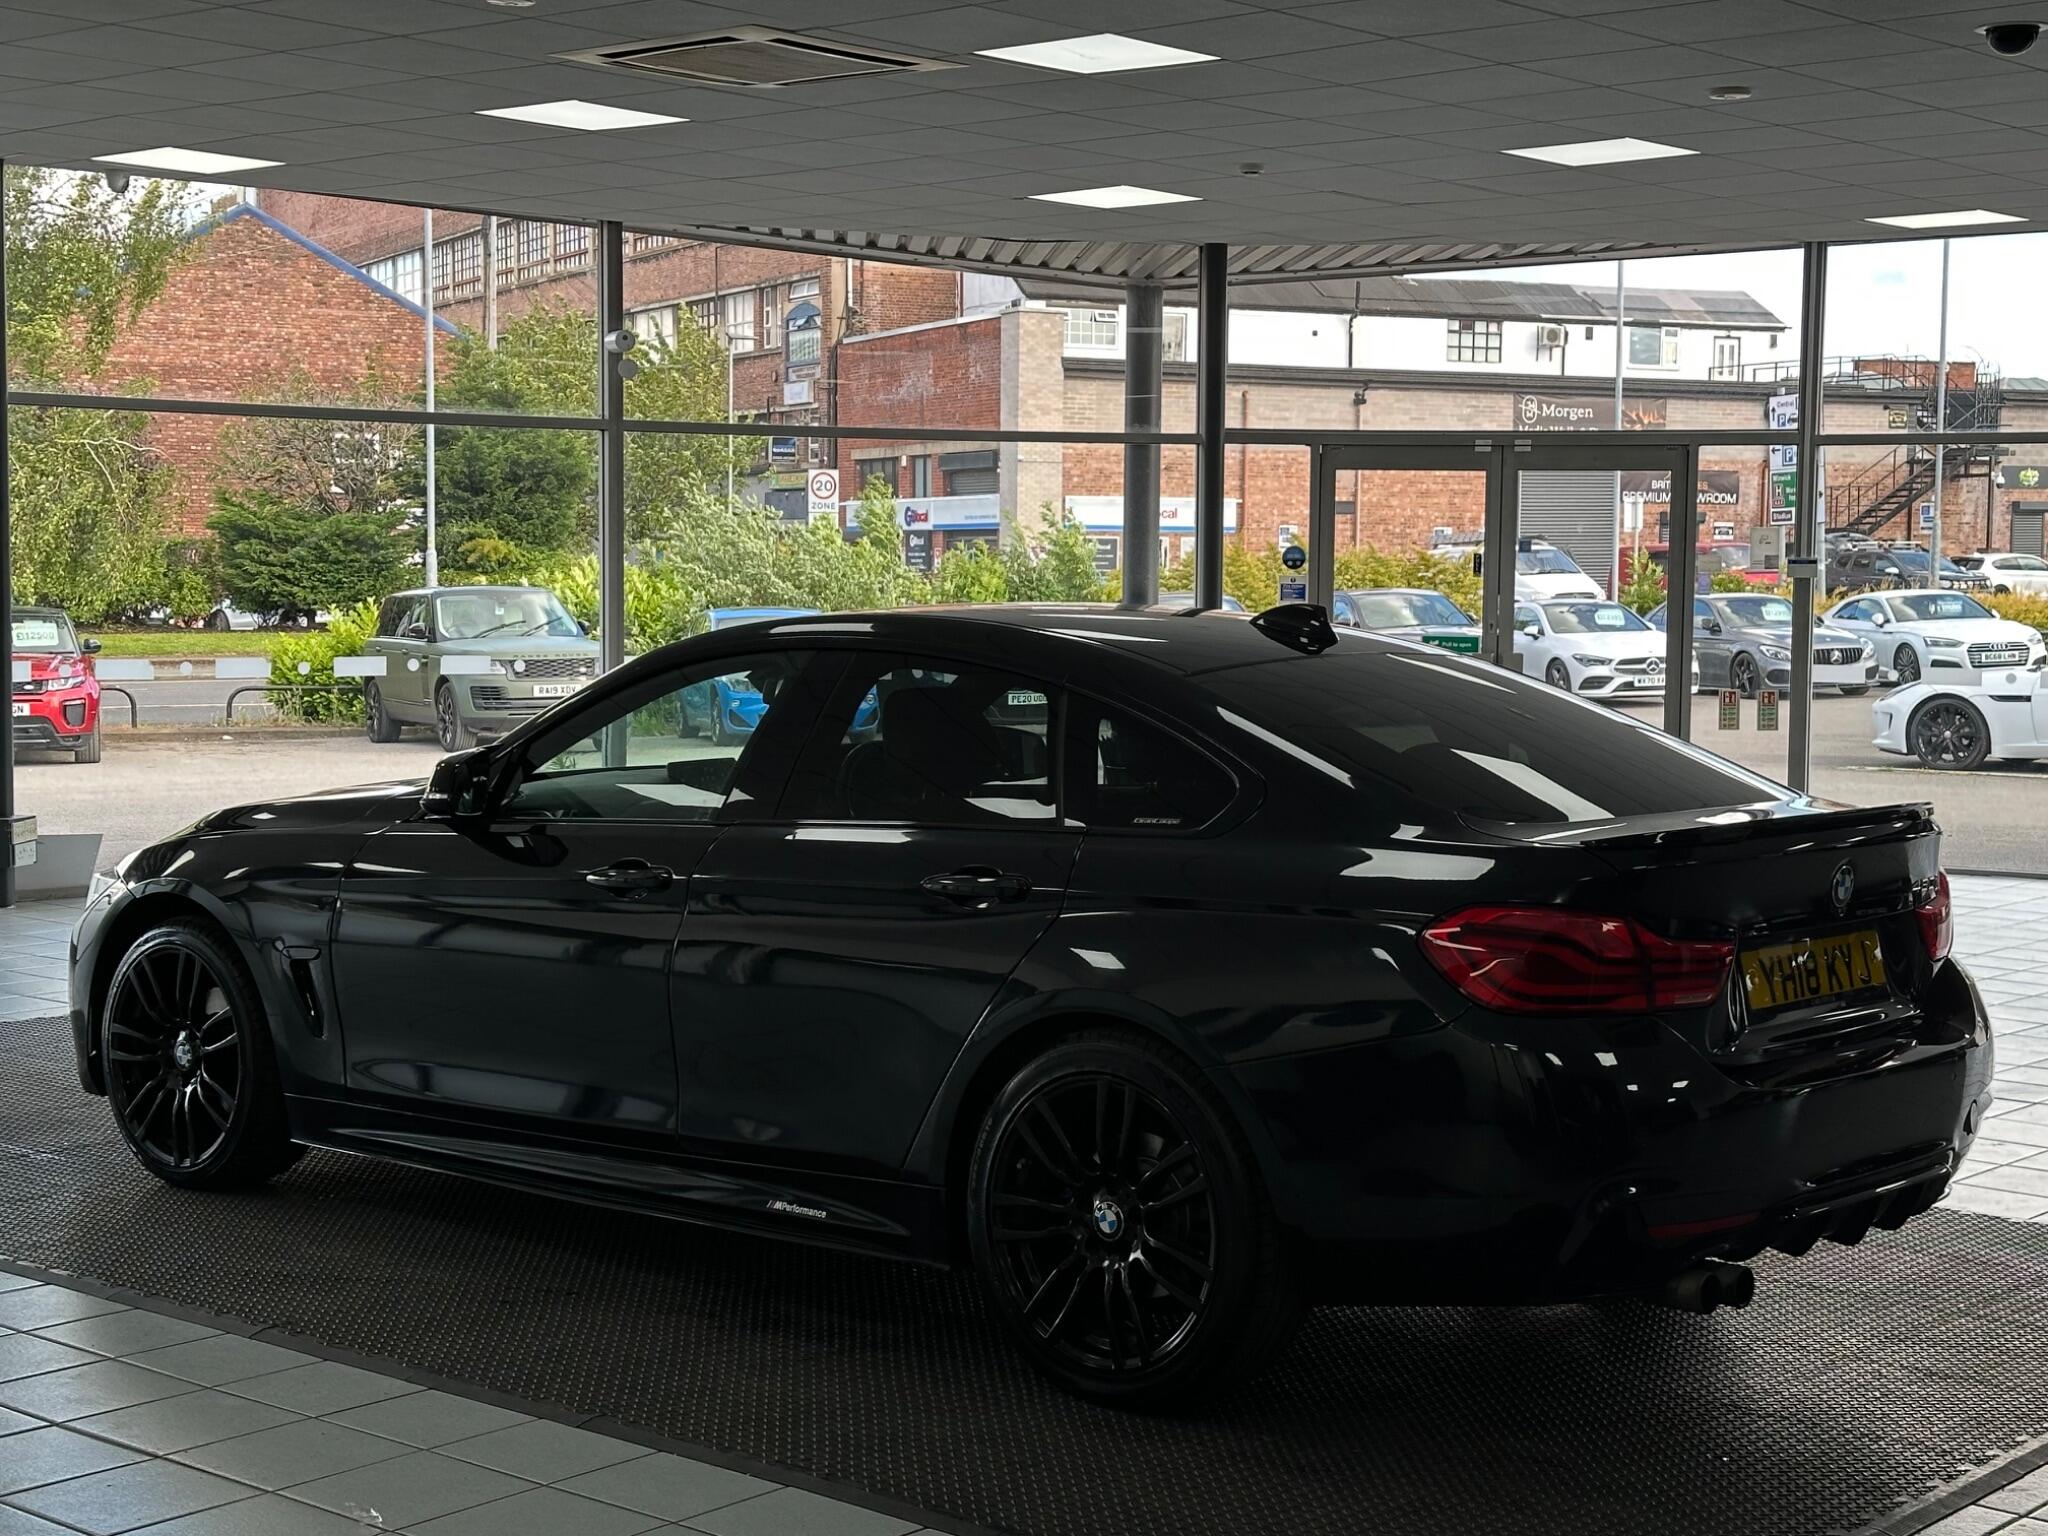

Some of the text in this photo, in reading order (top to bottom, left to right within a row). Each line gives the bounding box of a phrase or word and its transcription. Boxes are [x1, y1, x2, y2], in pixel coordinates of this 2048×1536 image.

[1541, 403, 1594, 420] Morgen
[815, 479, 833, 493] 20
[1651, 480, 1670, 490] BRIT
[811, 502, 836, 510] ZONE
[1011, 695, 1032, 704] PE20
[1758, 950, 1821, 1003] YH18
